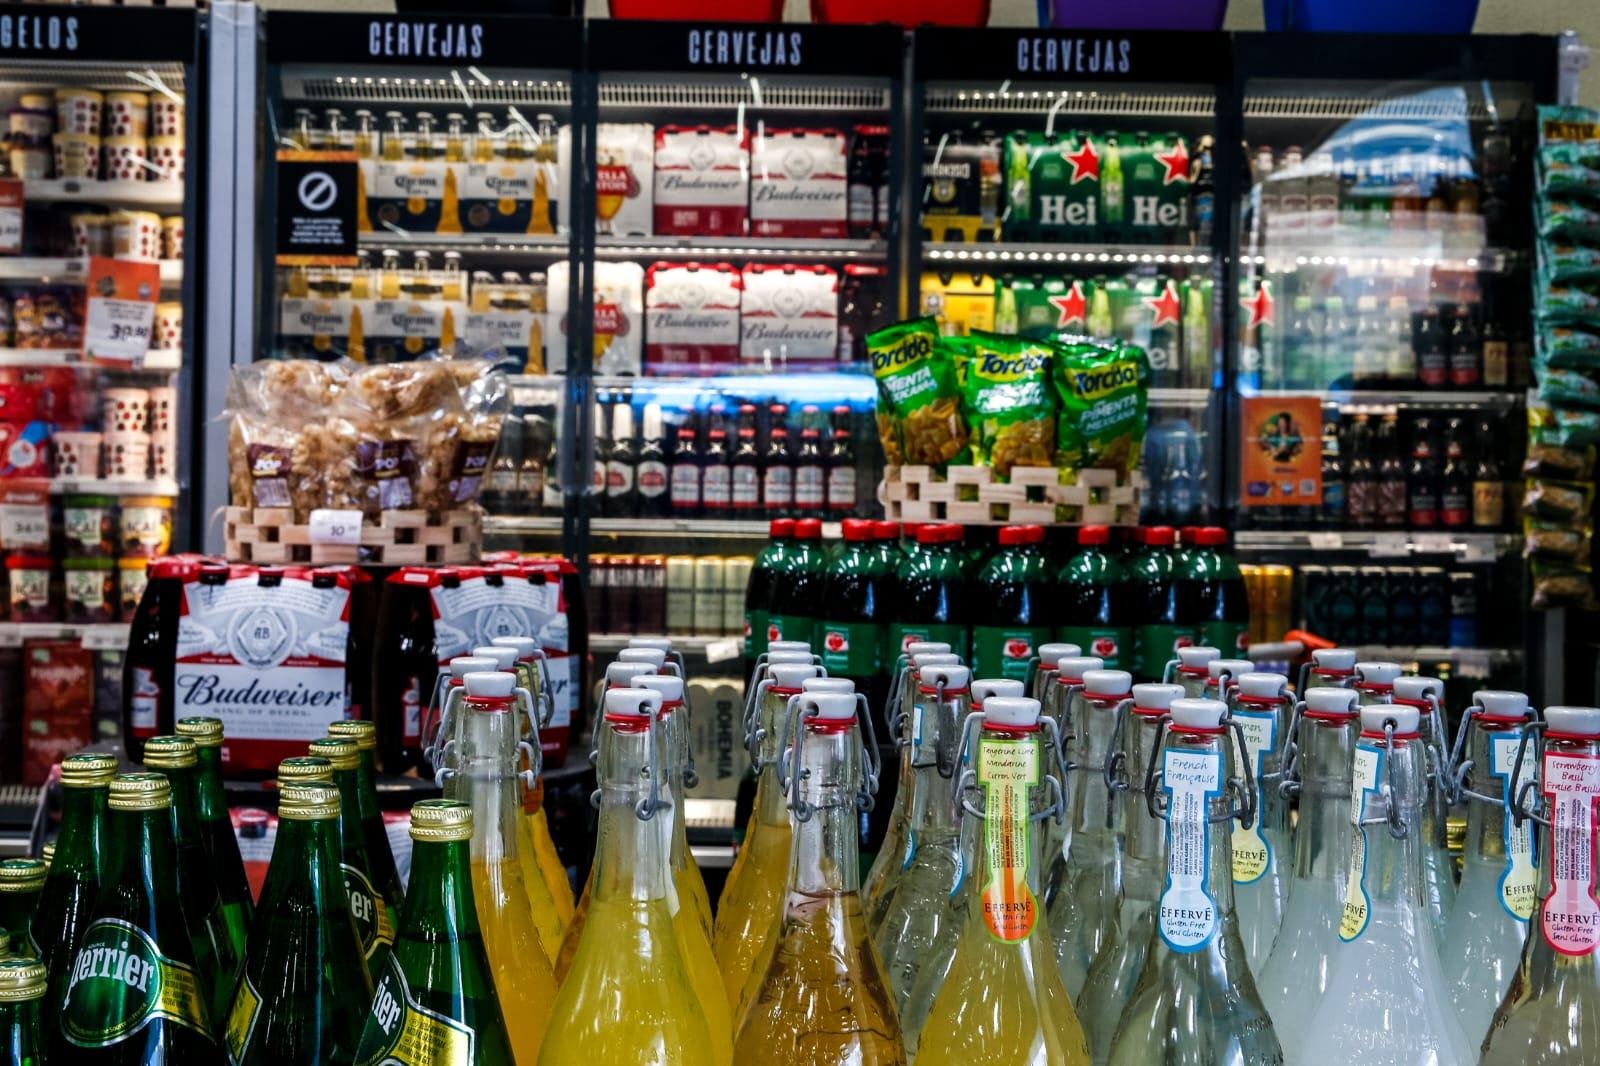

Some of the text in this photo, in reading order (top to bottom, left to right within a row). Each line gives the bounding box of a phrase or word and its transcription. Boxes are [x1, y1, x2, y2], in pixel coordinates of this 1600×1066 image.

[0, 15, 79, 50] GELOS
[368, 22, 483, 58] CERVEJAS
[687, 29, 802, 66] CERVEJAS
[1016, 38, 1131, 73] CERVEJAS
[664, 175, 740, 190] Budweiser
[756, 186, 844, 202] Budweiser
[1039, 195, 1097, 225] Hei
[1132, 196, 1188, 226] Hei
[655, 313, 731, 329] Budweiser
[745, 324, 834, 341] Budweiser
[1075, 366, 1136, 395] Torcida
[177, 674, 343, 708] Budweiser
[213, 707, 242, 716] KING
[248, 708, 263, 716] OF
[716, 701, 733, 780] BOHEMIA
[986, 759, 1028, 769] Mandarine
[1172, 756, 1208, 771] French
[1552, 760, 1598, 776] Strawberry
[987, 771, 1028, 781] Citron Vert
[1167, 769, 1215, 785] Française
[1562, 772, 1584, 783] Basil
[1546, 781, 1573, 793] Fraise
[1505, 884, 1537, 897] EFFERV
[984, 897, 1031, 914] EFFERVÉ
[1161, 905, 1213, 922] EFFERVÉ
[1544, 910, 1600, 926] EFFERVÉ
[1551, 924, 1594, 935] Gluten Free
[63, 940, 155, 1011] perrier
